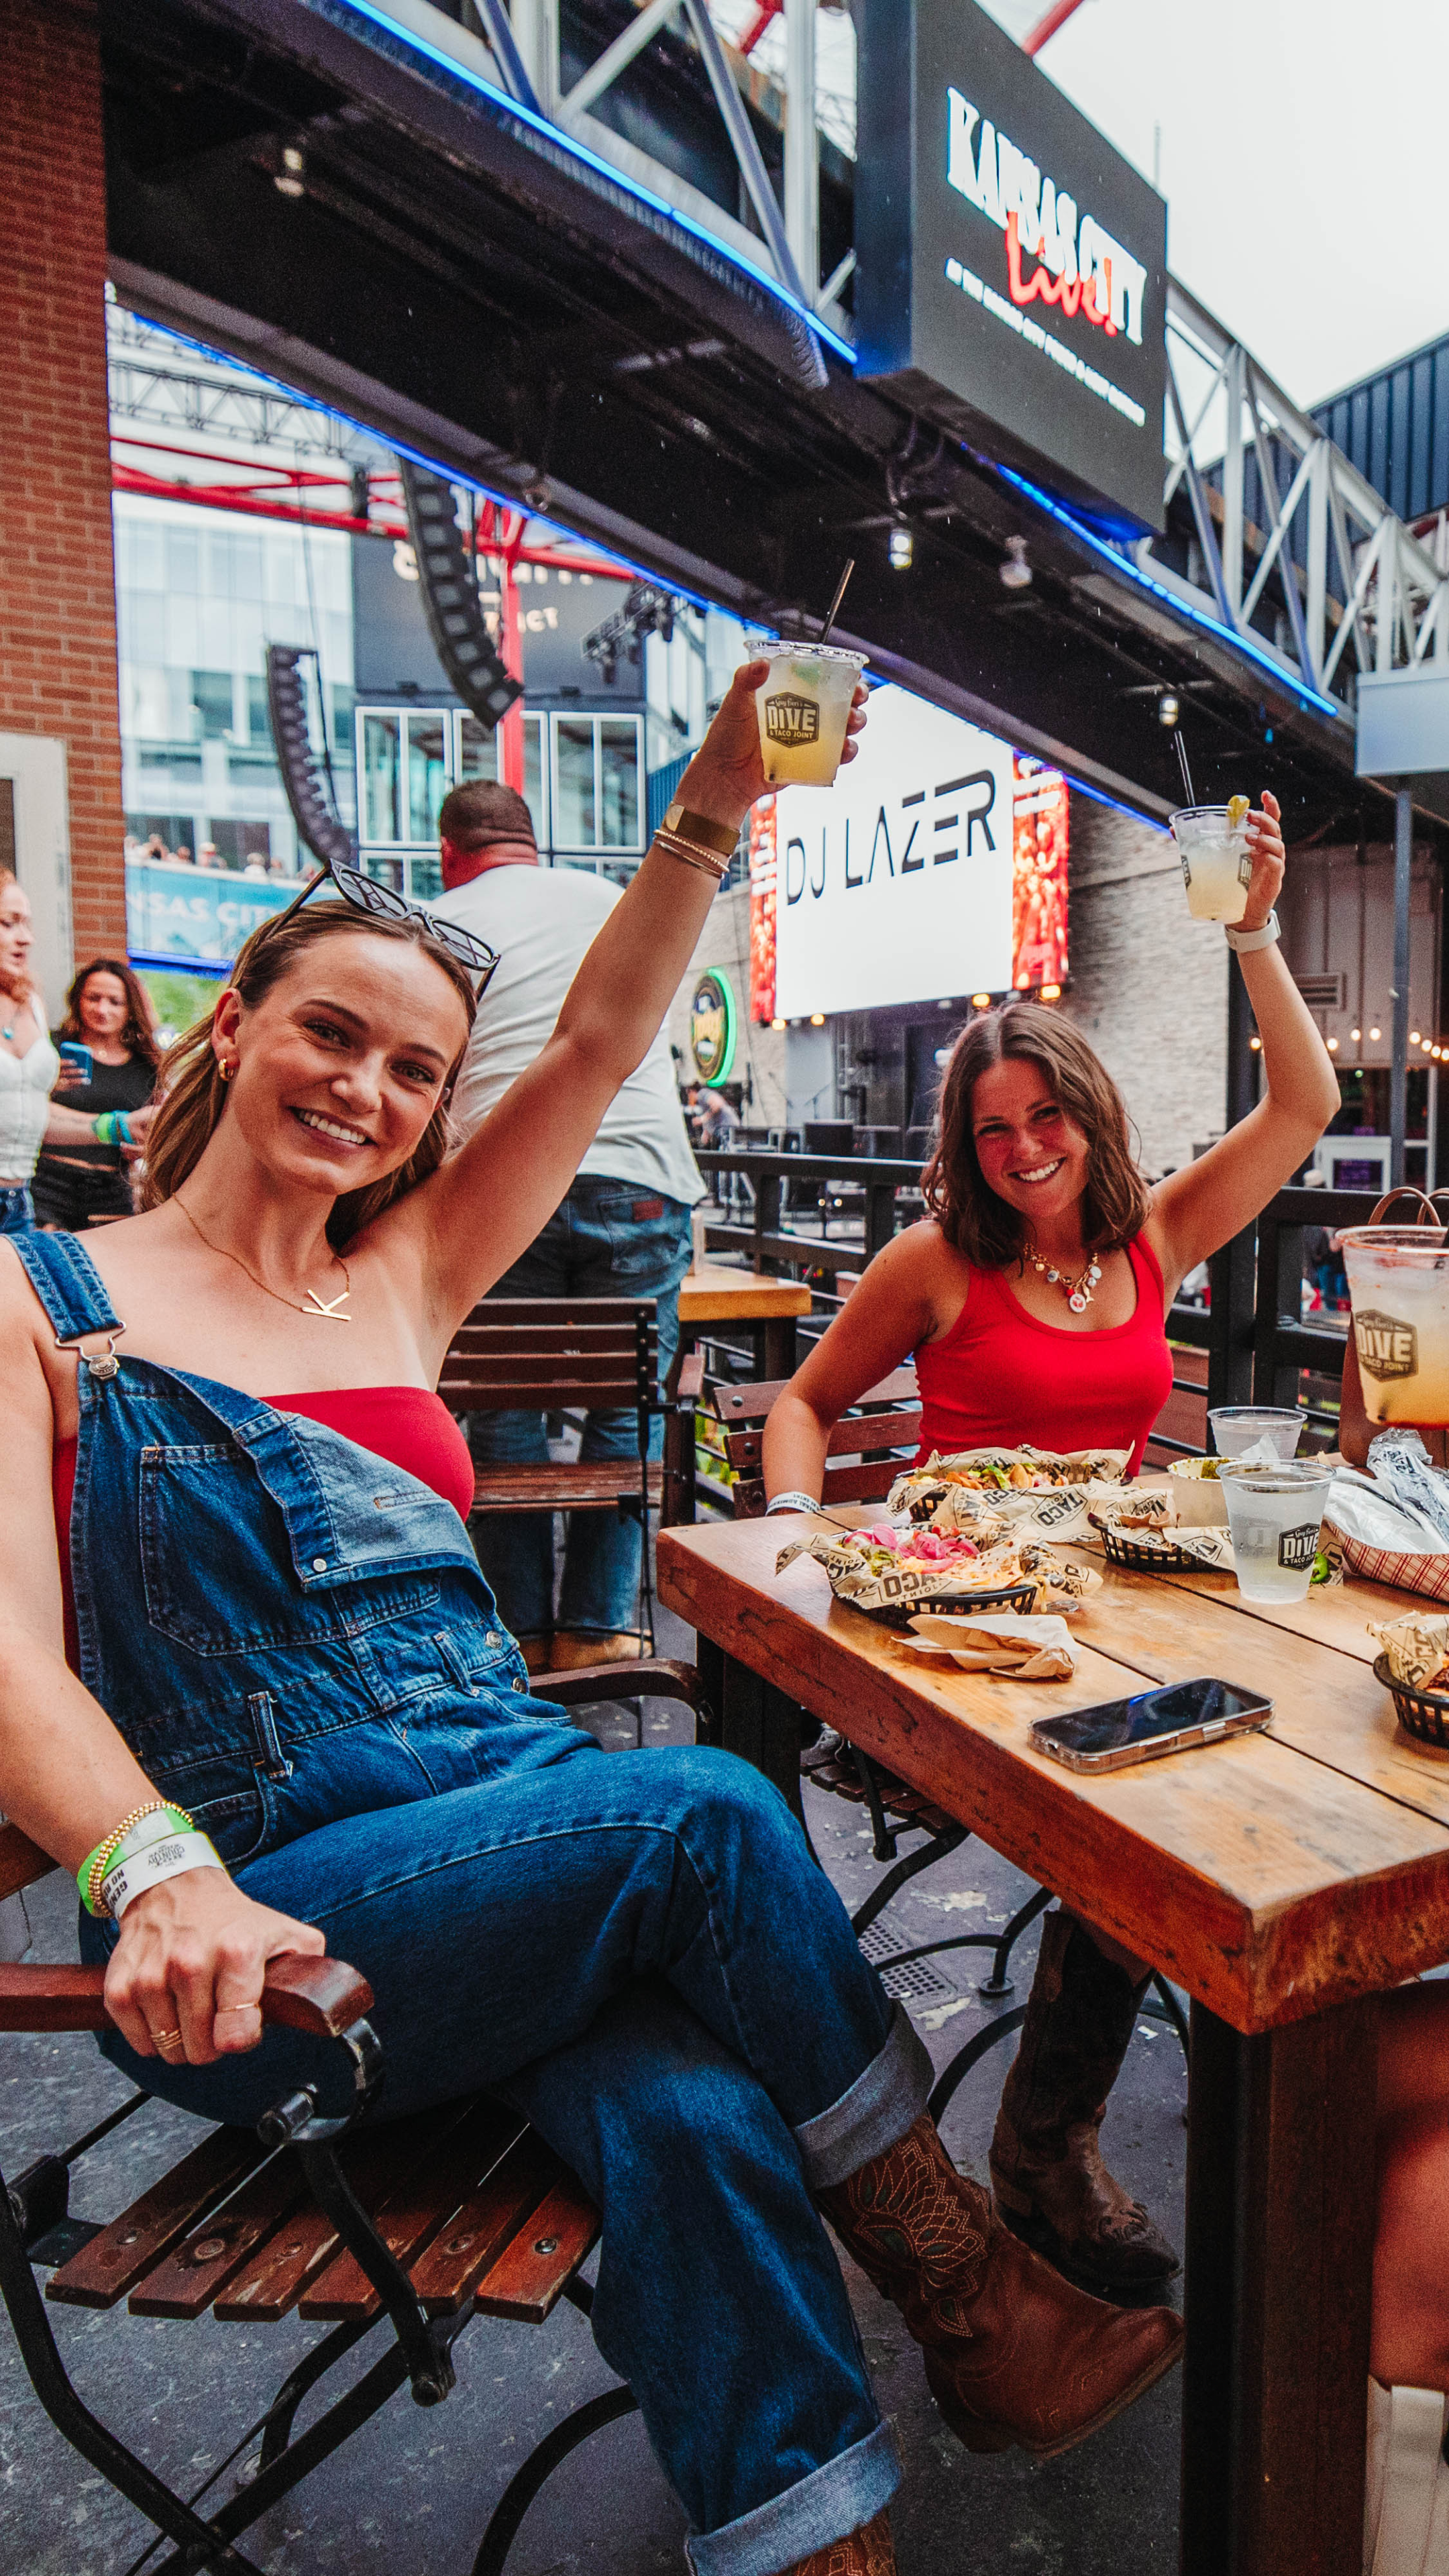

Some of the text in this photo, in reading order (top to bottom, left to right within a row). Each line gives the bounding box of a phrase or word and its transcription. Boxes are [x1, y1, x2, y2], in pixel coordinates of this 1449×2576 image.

[1078, 213, 1148, 345] CITY
[767, 705, 816, 731] DIVE
[793, 731, 814, 739] JOINT
[787, 826, 826, 906] DJ
[846, 769, 996, 889] LAZER
[1356, 1324, 1412, 1363] DIVE
[1037, 1491, 1084, 1526] TACO
[148, 1845, 186, 1866] COUNTRY
